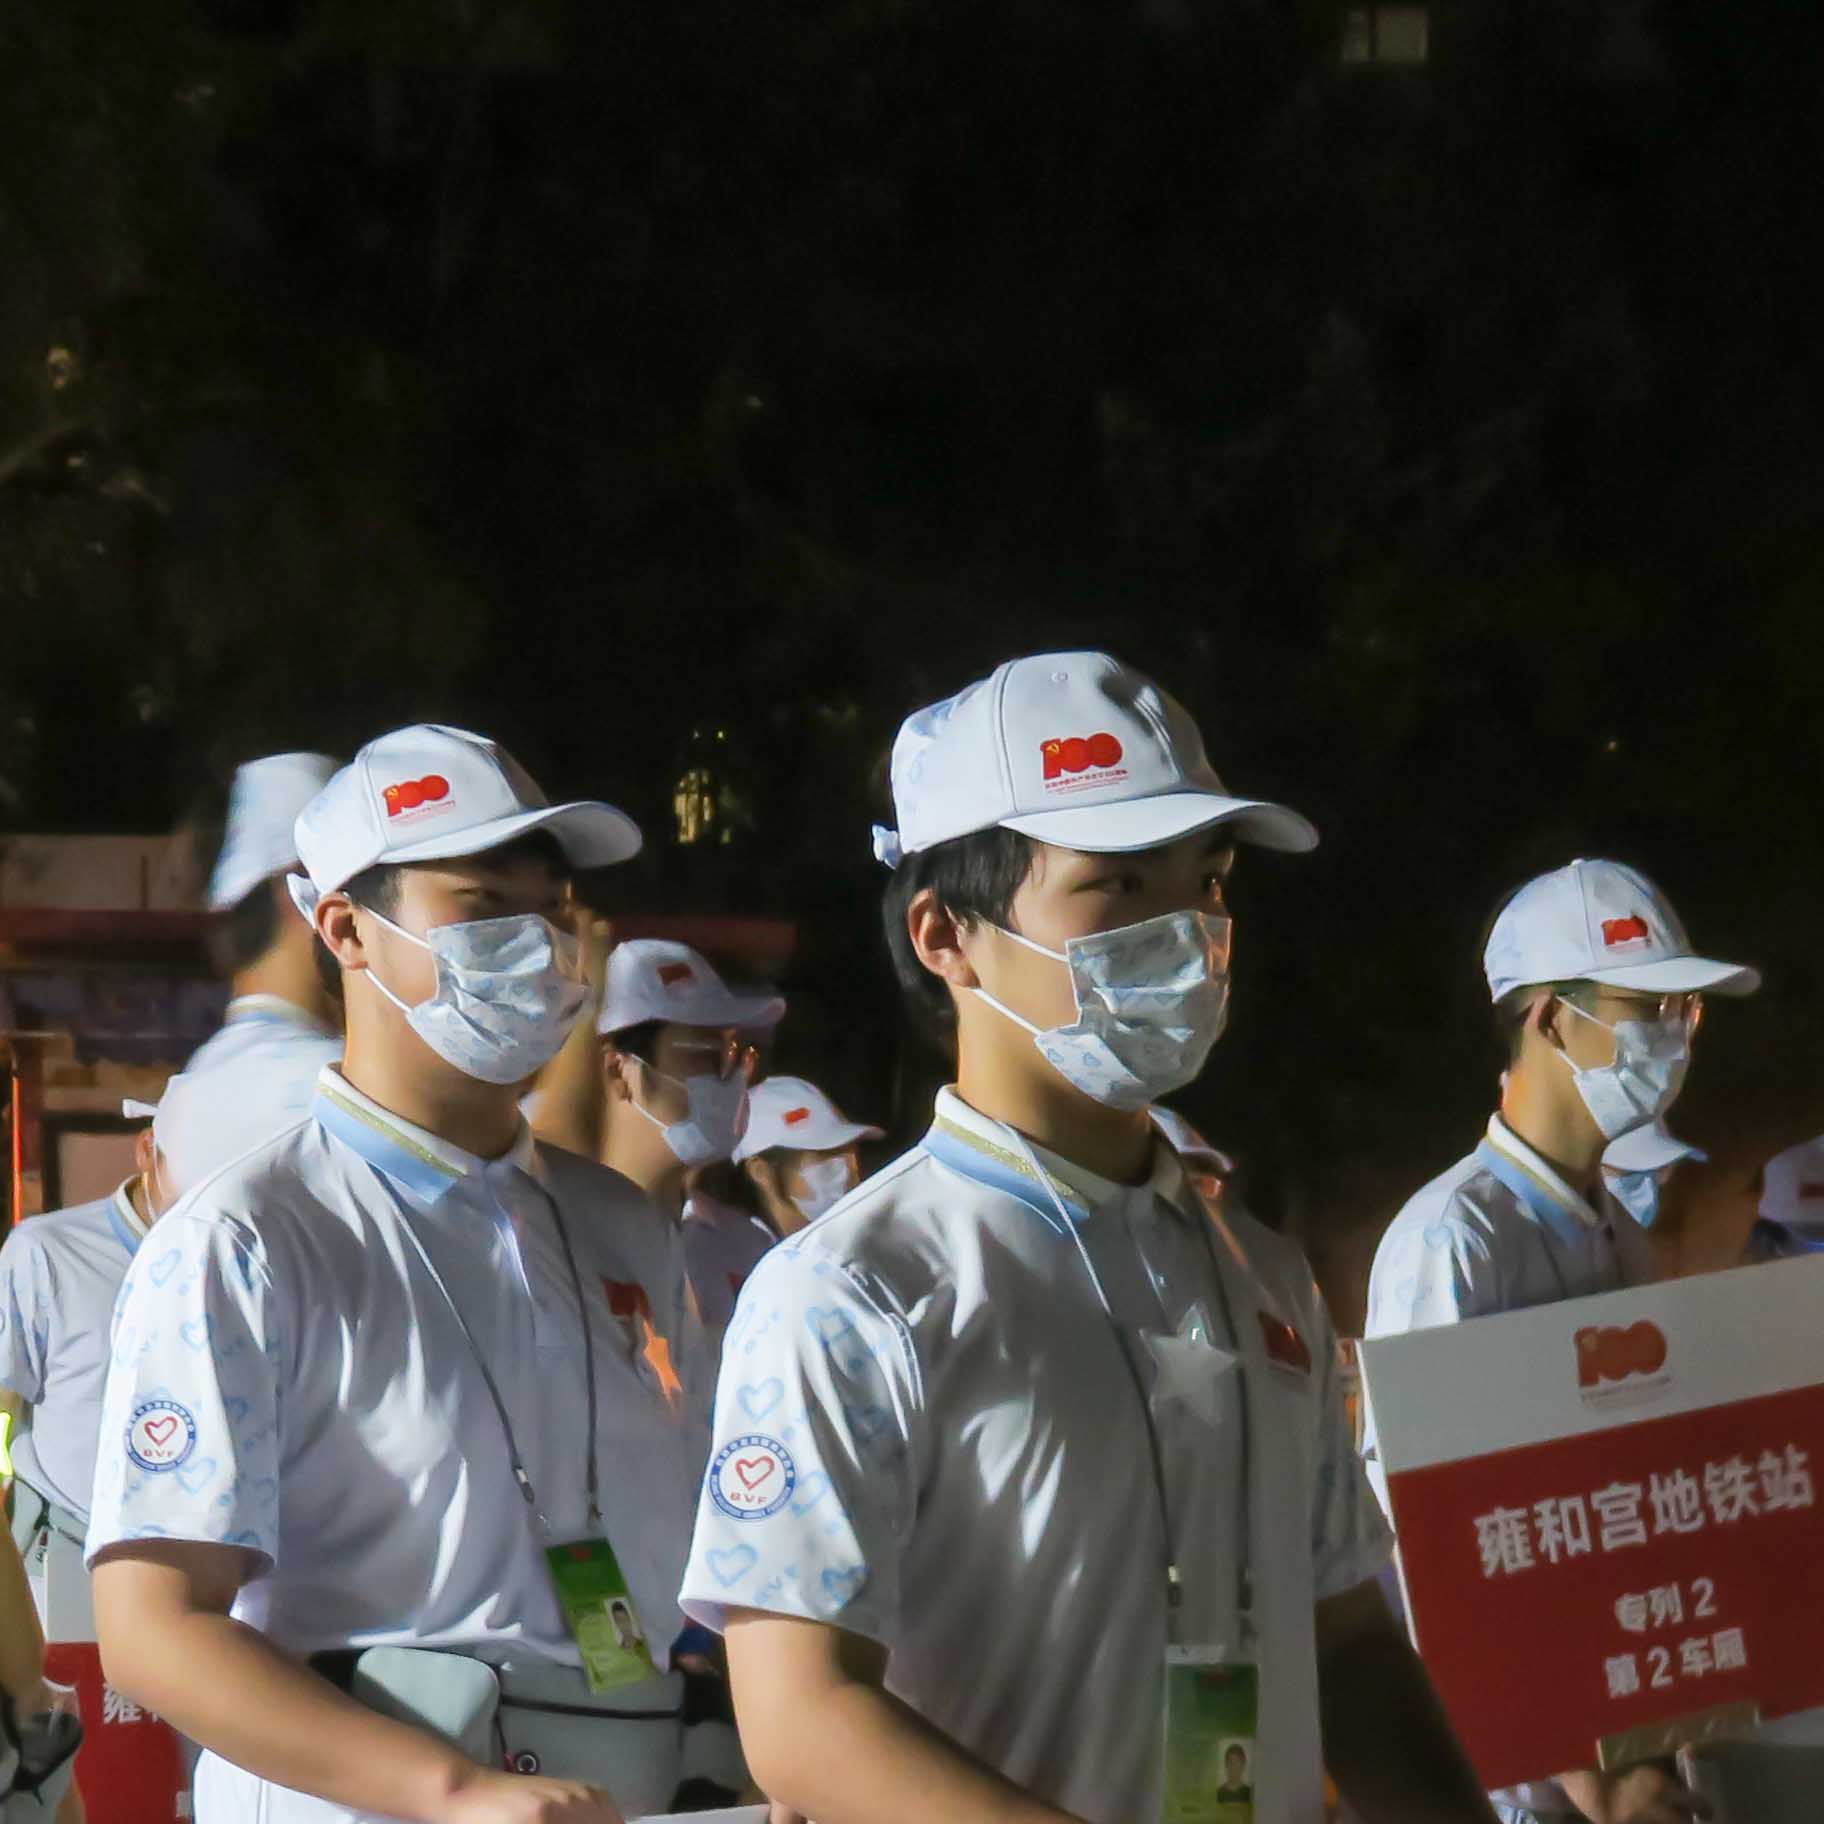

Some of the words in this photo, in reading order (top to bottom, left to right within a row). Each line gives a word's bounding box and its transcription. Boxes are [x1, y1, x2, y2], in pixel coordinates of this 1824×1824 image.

[1474, 1444, 1814, 1578] 雍和宫地铁站
